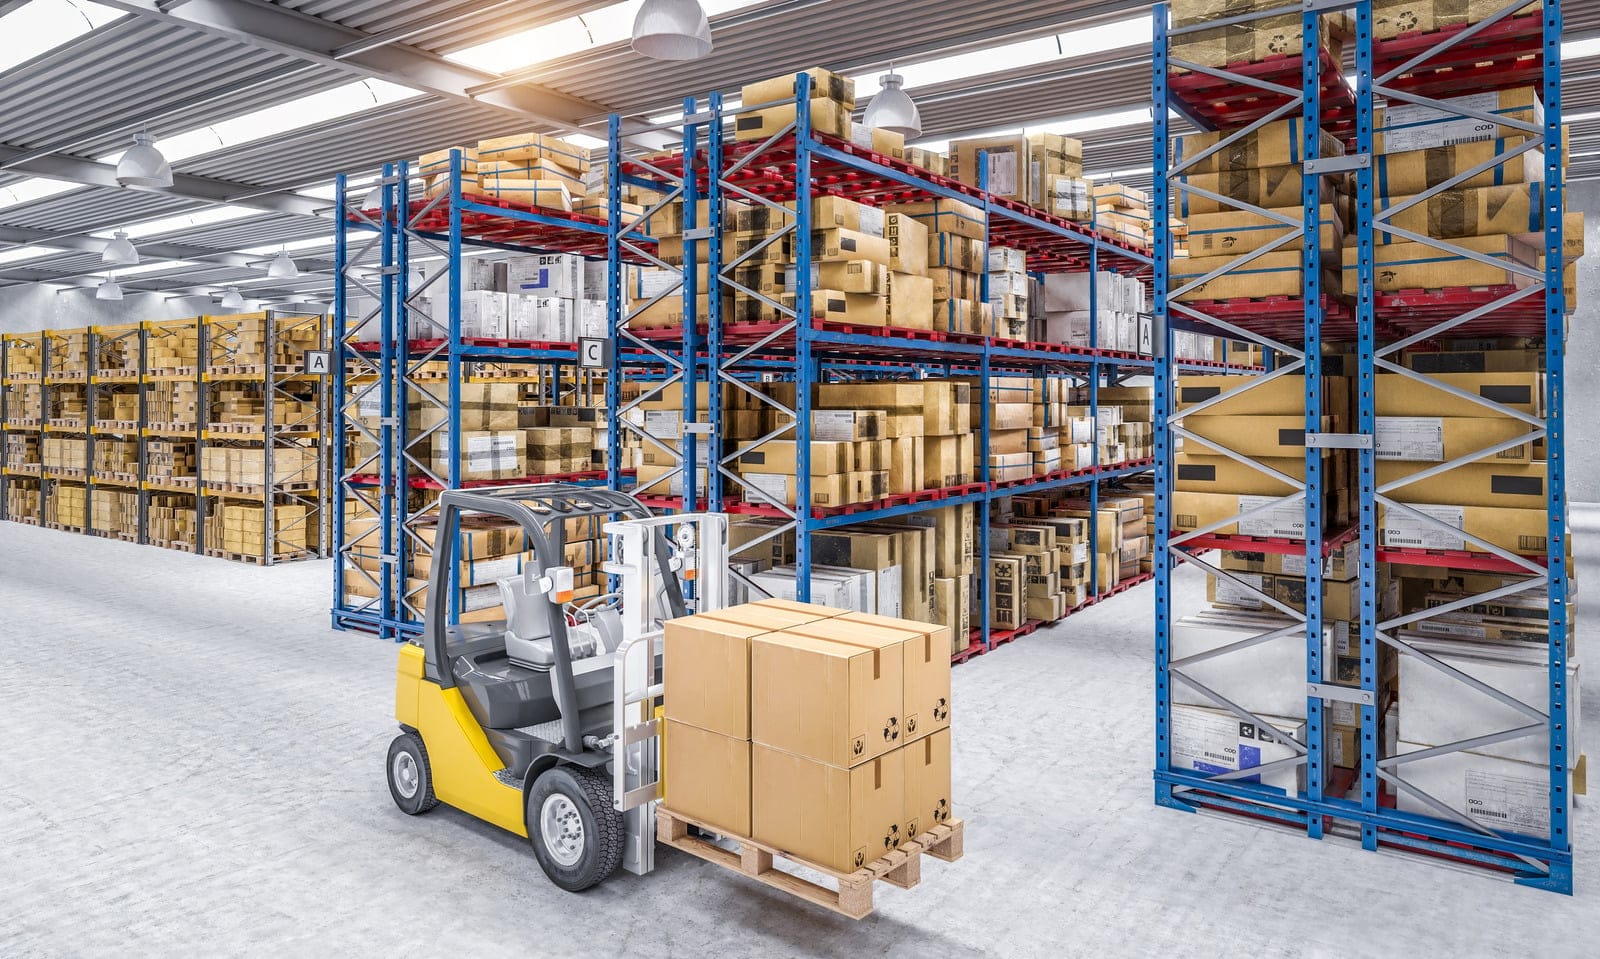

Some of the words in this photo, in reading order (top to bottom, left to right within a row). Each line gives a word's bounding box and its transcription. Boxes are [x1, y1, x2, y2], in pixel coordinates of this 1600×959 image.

[1474, 123, 1494, 132] COD
[1142, 323, 1150, 346] A
[588, 344, 598, 361] C
[314, 355, 324, 369] A
